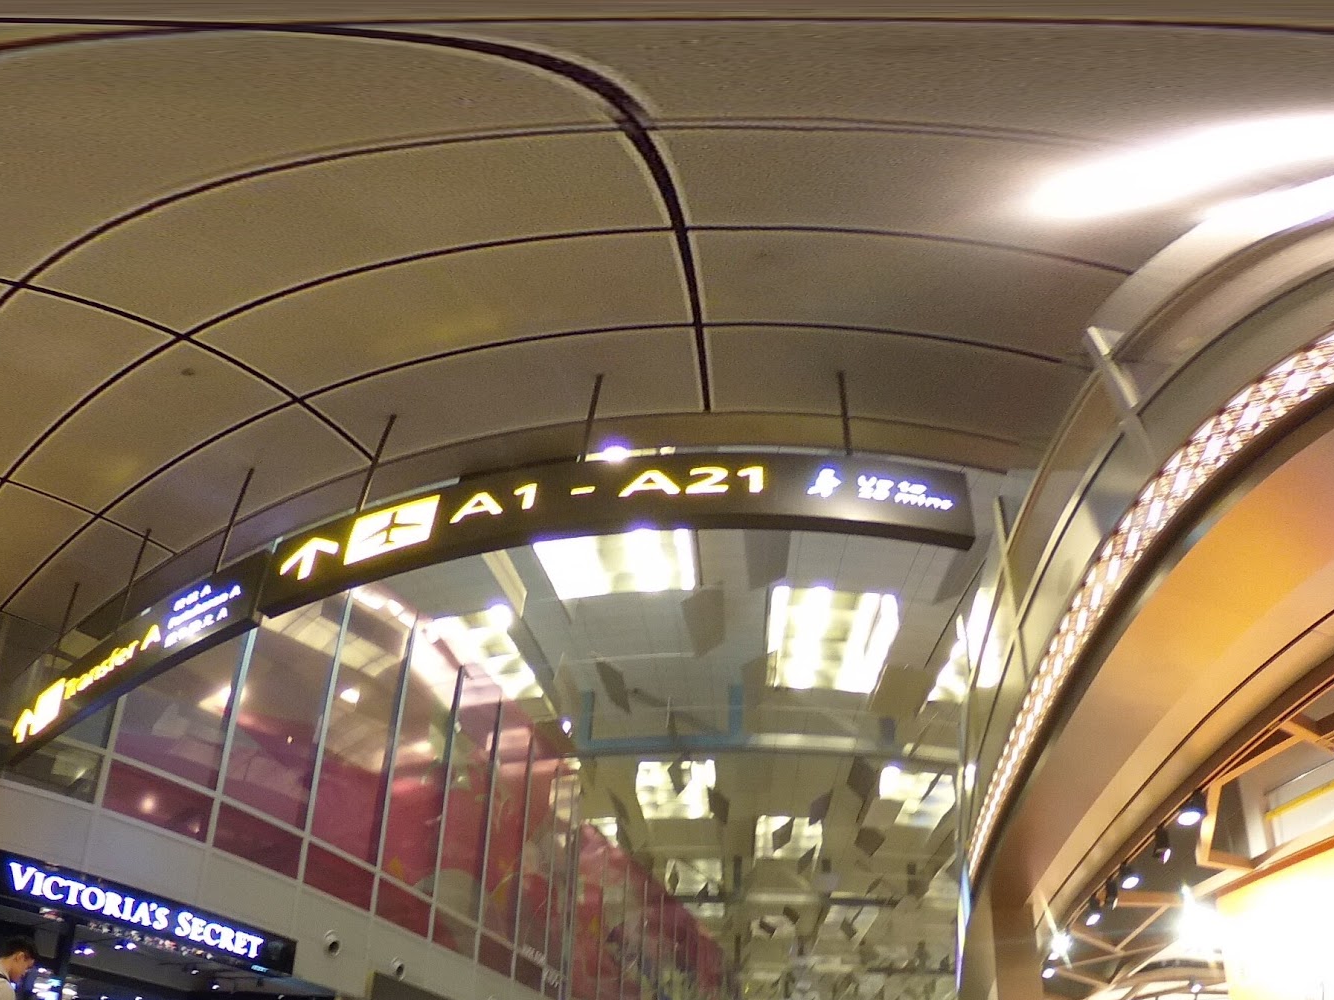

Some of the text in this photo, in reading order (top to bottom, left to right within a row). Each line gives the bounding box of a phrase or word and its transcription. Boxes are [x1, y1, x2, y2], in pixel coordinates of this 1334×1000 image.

[449, 482, 539, 523] A1
[618, 465, 765, 499] A21
[64, 640, 140, 700] Transfer
[140, 624, 161, 651] A
[8, 861, 265, 959] VICTORIA'S SECRET
